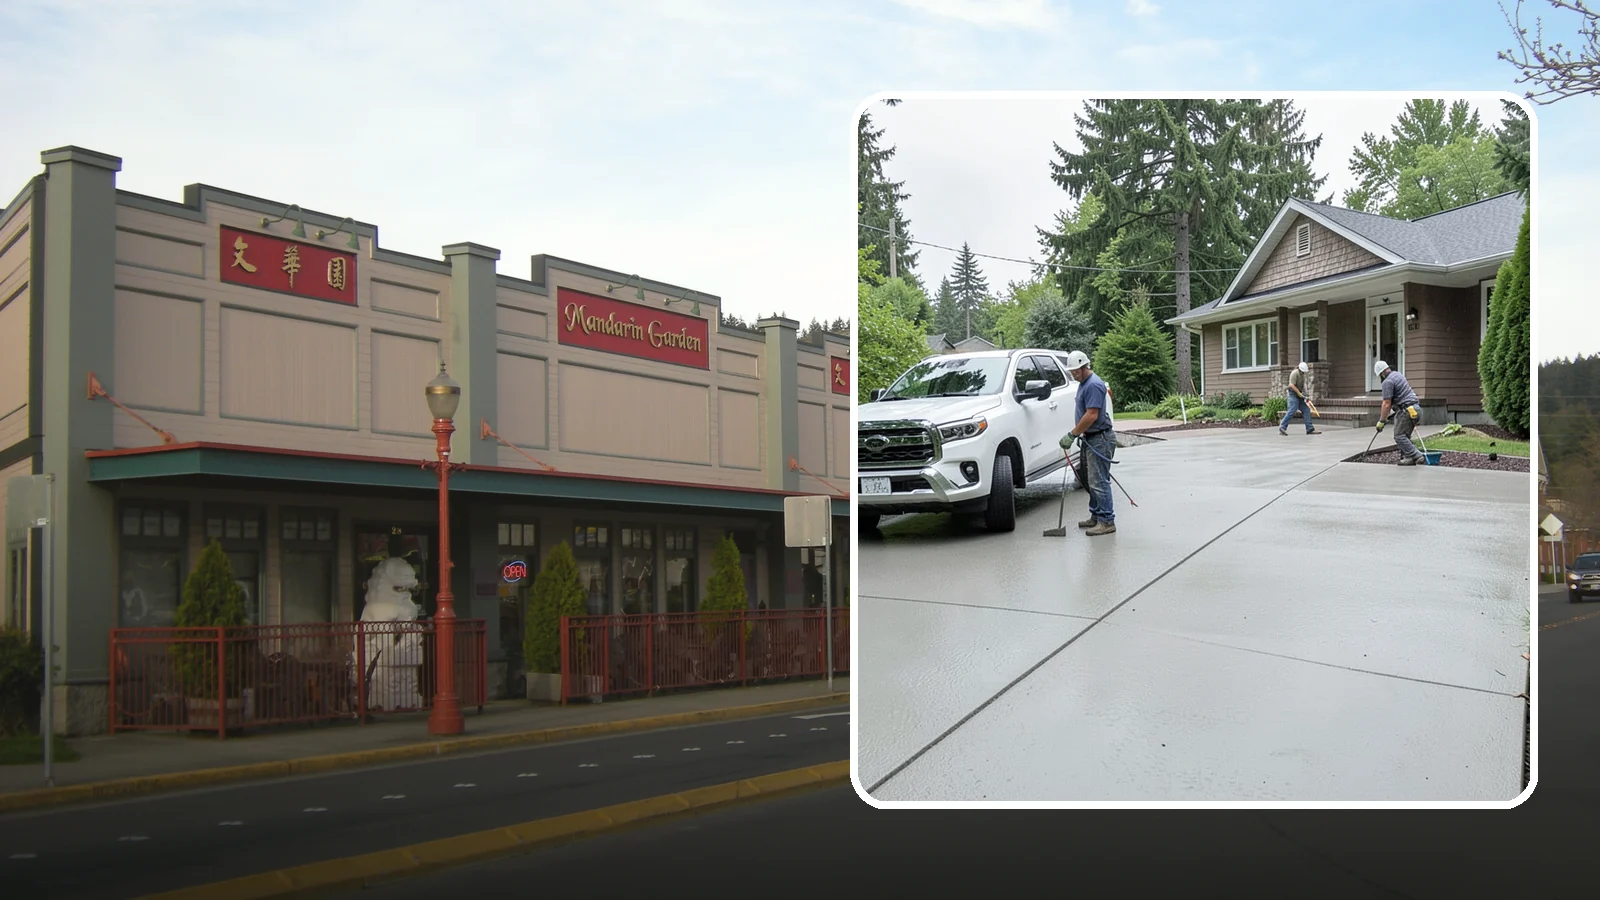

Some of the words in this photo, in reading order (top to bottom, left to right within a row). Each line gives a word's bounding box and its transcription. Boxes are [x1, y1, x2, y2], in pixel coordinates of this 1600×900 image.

[231, 236, 345, 290] 文華園
[564, 302, 644, 341] Mandarin
[648, 320, 701, 352] Garden
[503, 565, 527, 578] OPEN
